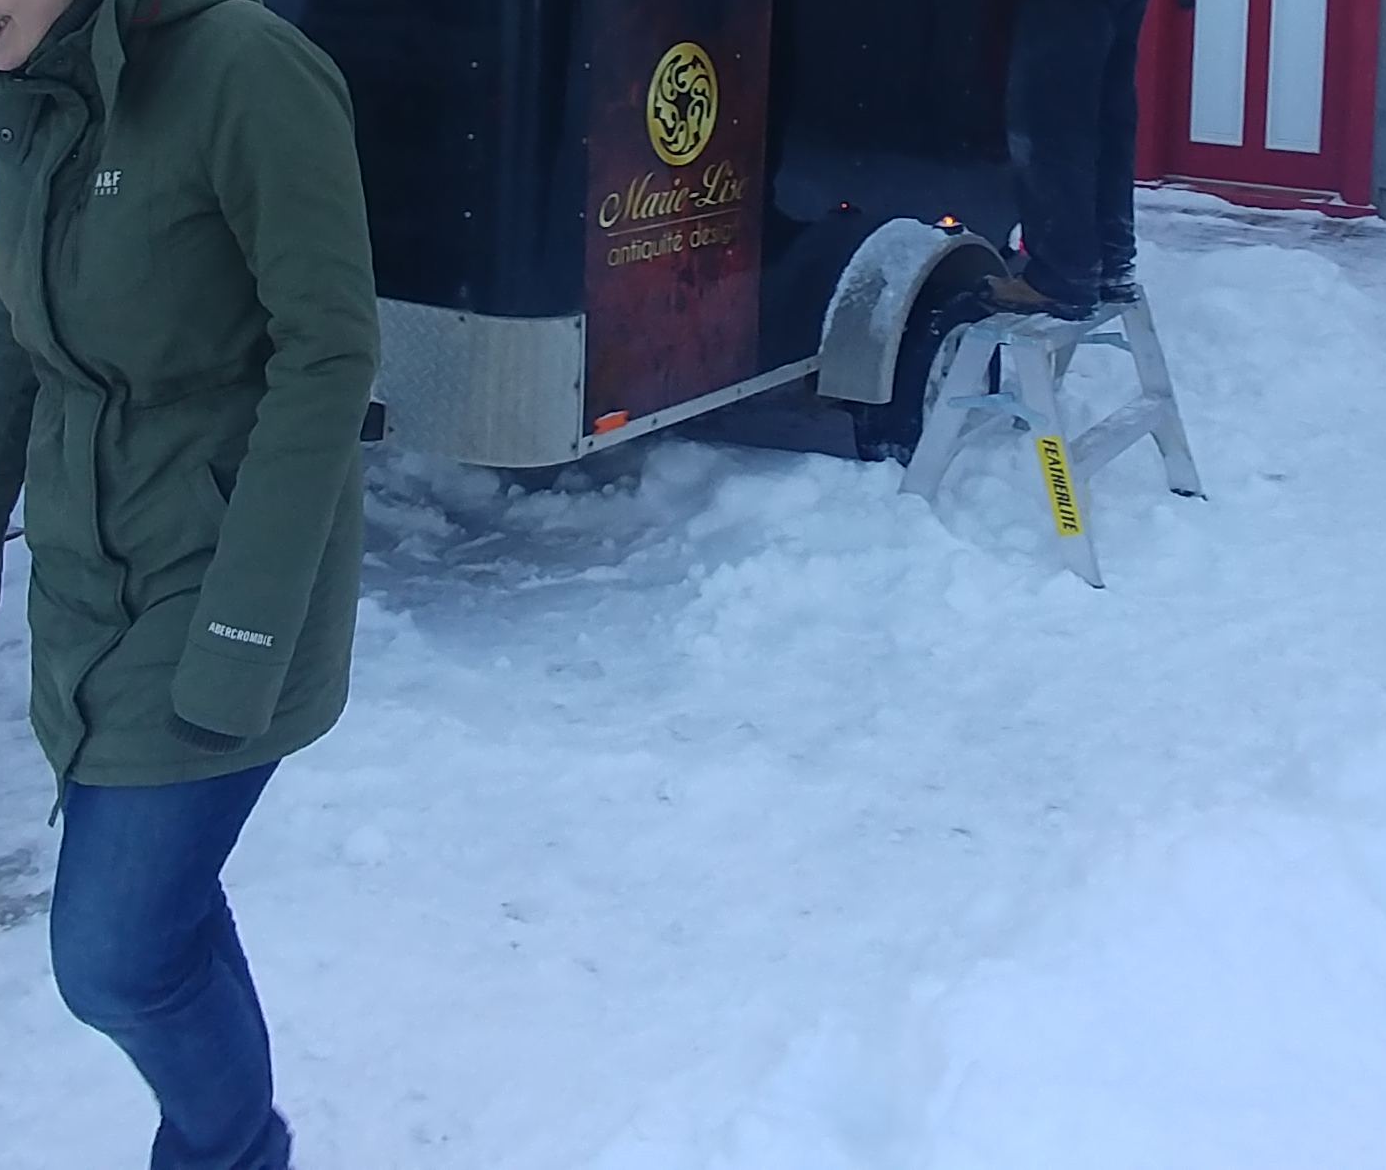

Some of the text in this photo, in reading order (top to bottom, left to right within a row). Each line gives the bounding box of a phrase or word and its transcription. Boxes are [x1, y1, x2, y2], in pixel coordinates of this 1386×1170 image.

[95, 171, 121, 187] A&F
[689, 221, 737, 249] desig
[1042, 439, 1079, 532] FEATHERLITE
[208, 621, 274, 647] ABERCROMBIE
